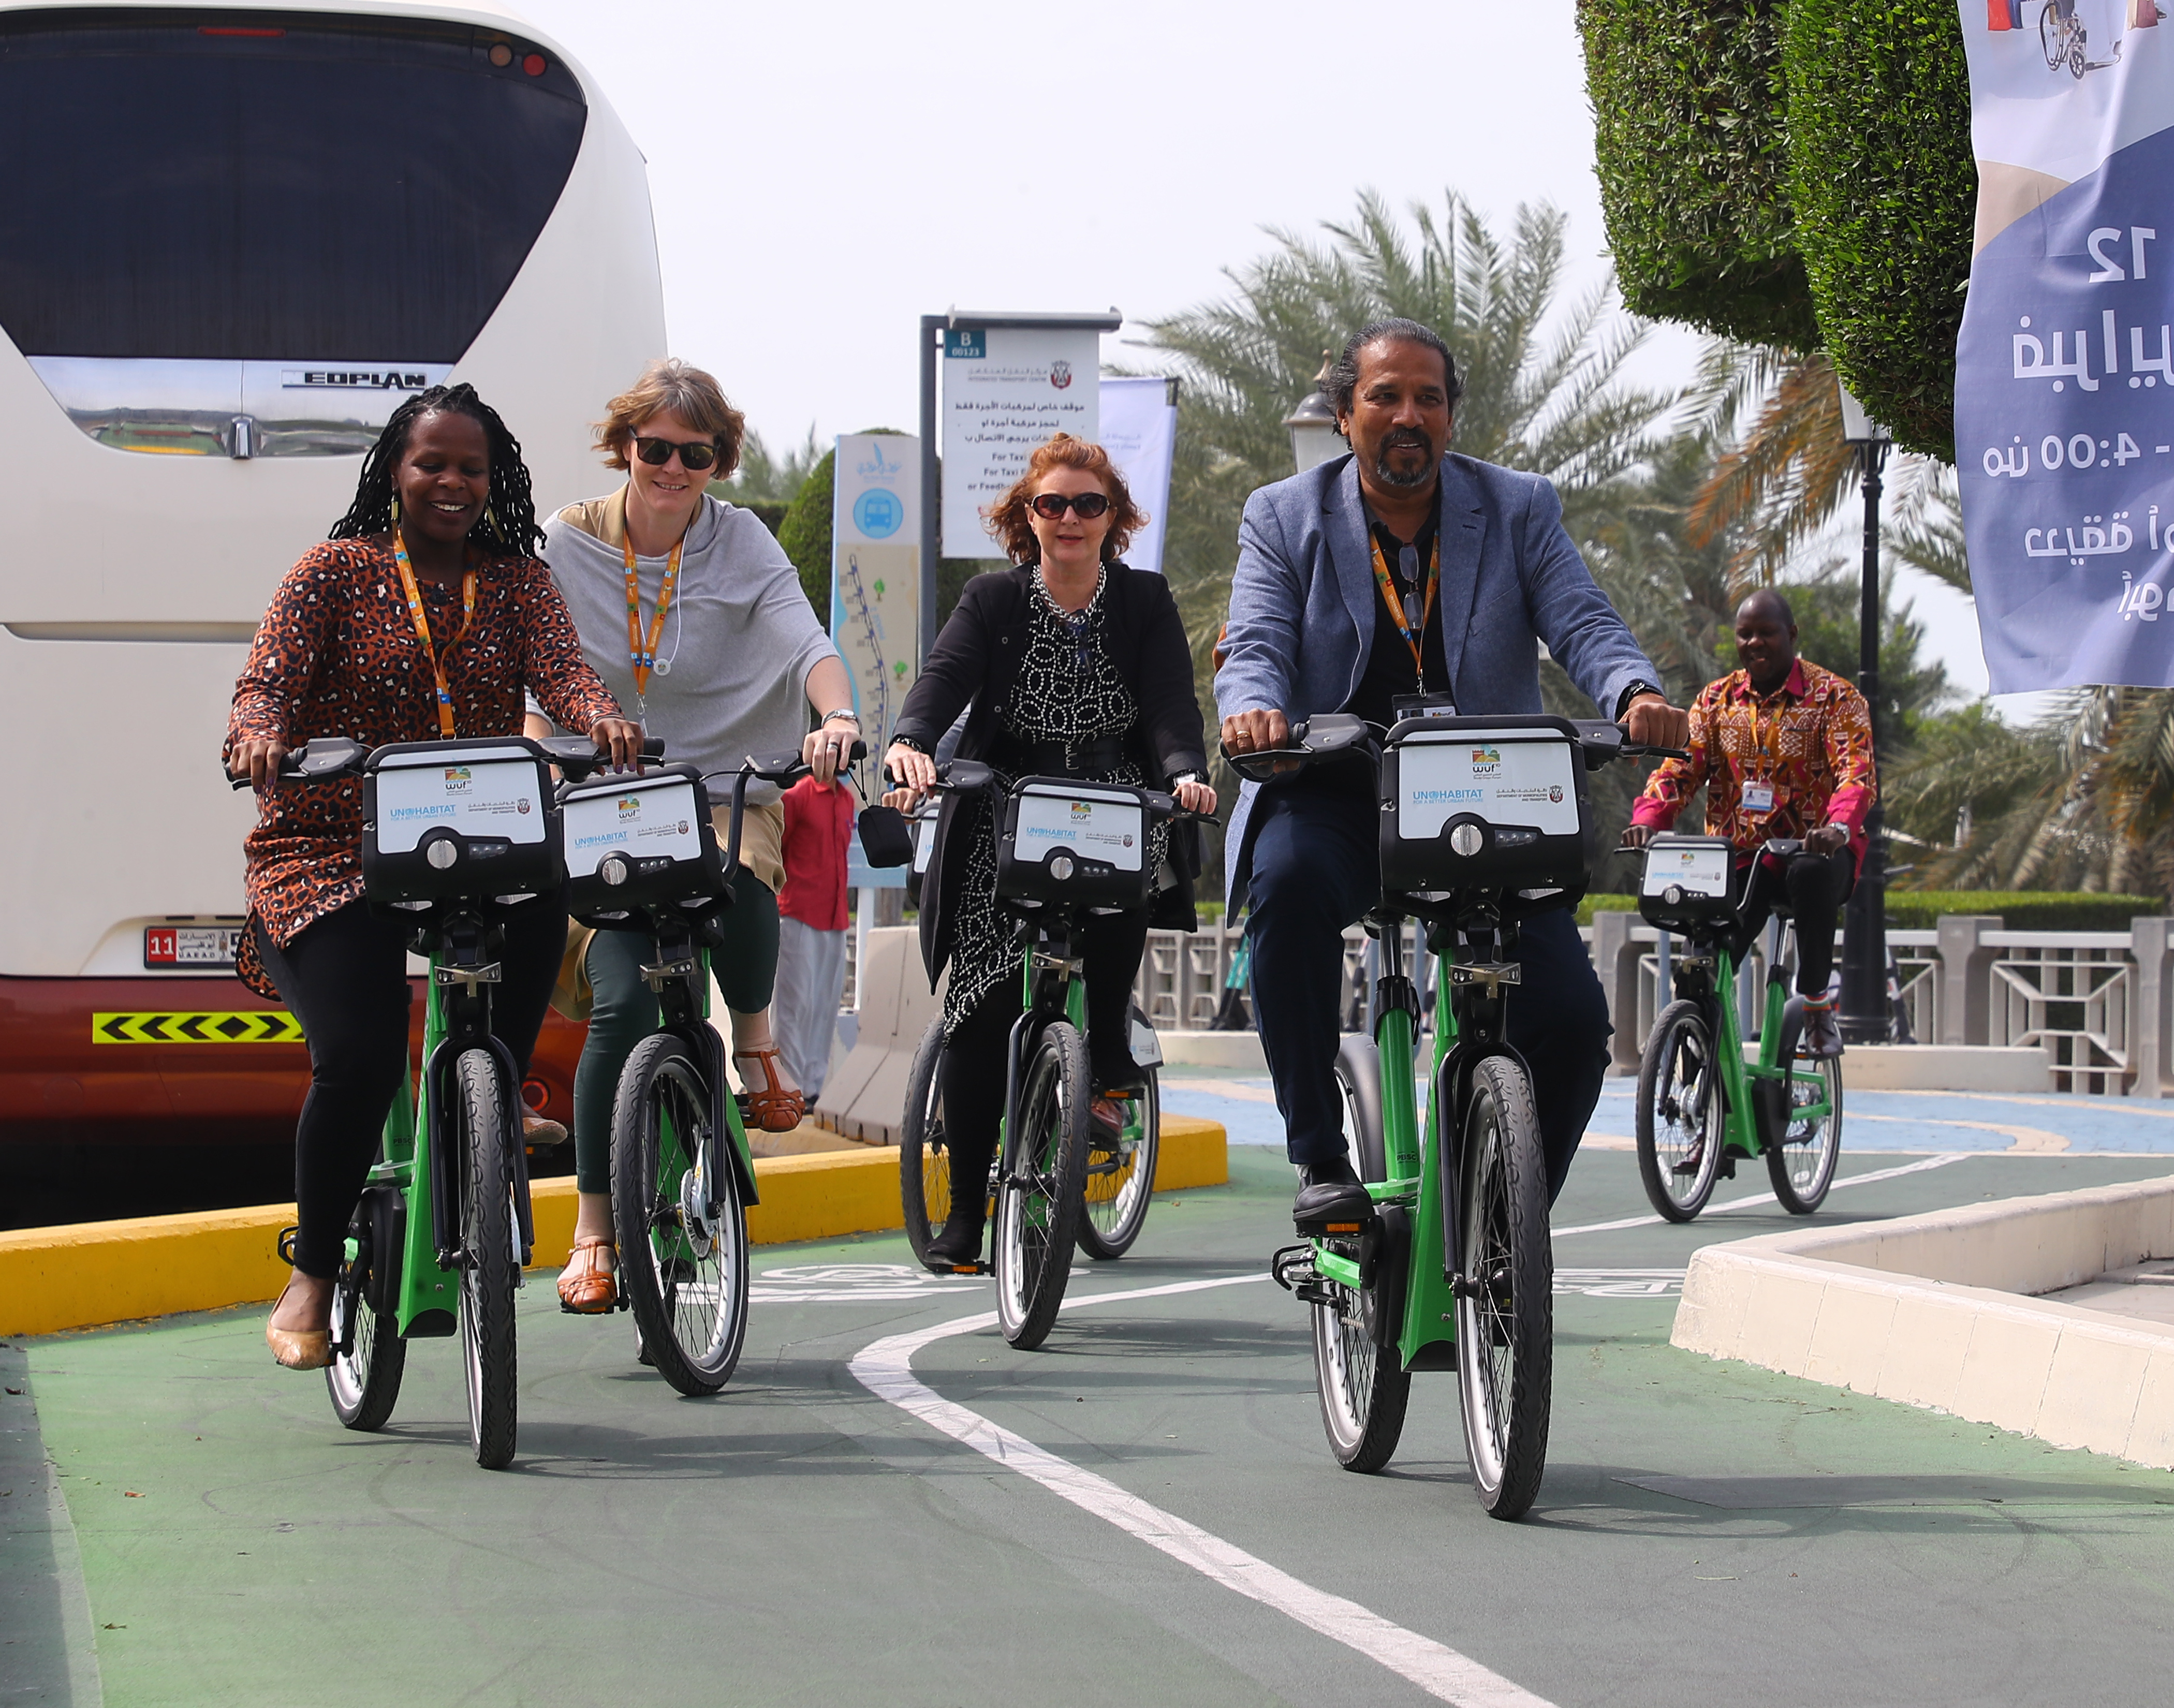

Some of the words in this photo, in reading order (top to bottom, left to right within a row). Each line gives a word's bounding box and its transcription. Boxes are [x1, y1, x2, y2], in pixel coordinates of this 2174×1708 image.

[961, 332, 971, 346] B
[952, 348, 979, 357] 00123
[992, 453, 1006, 461] For
[1002, 467, 1018, 476] Taxi
[980, 482, 1005, 491] Feedb
[151, 936, 174, 955] 11
